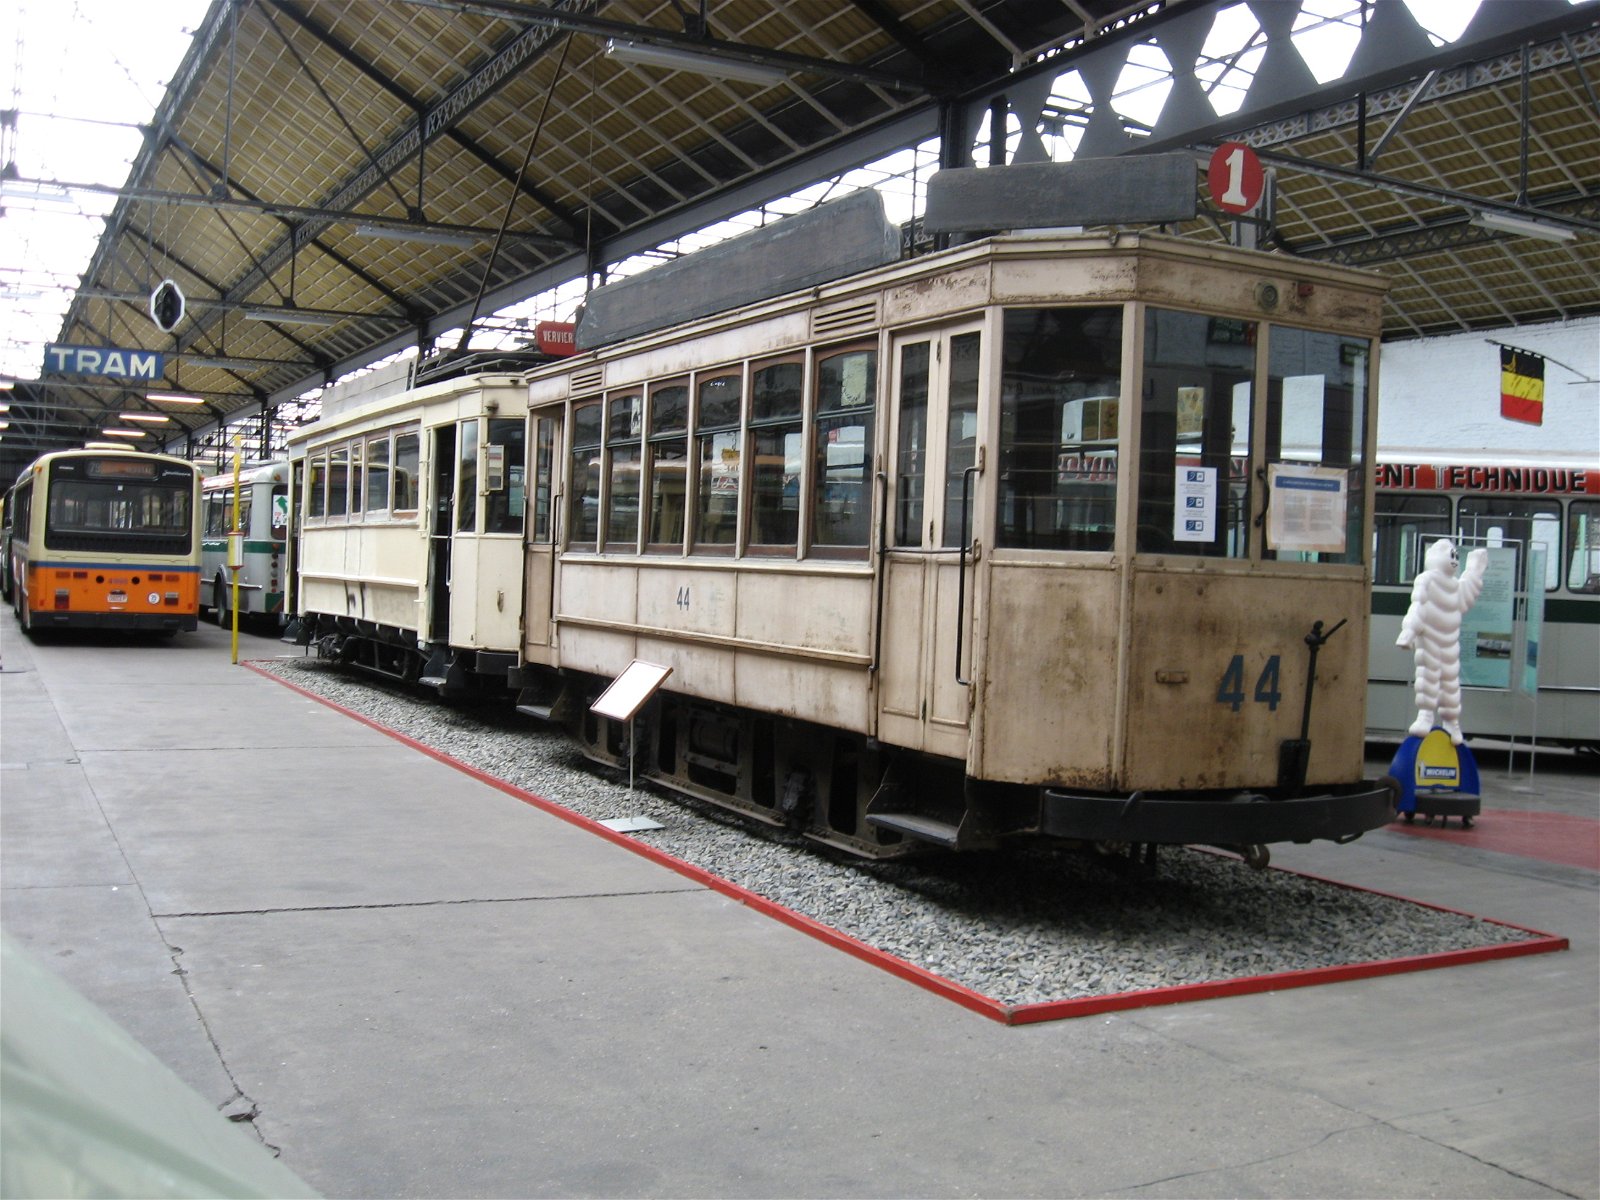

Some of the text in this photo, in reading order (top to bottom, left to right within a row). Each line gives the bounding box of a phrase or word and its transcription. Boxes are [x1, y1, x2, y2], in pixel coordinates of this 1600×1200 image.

[1221, 148, 1247, 207] 1
[50, 347, 156, 379] TRAM
[1431, 464, 1588, 494] TECHNIQUE
[676, 586, 690, 611] 44
[1216, 654, 1282, 712] 44
